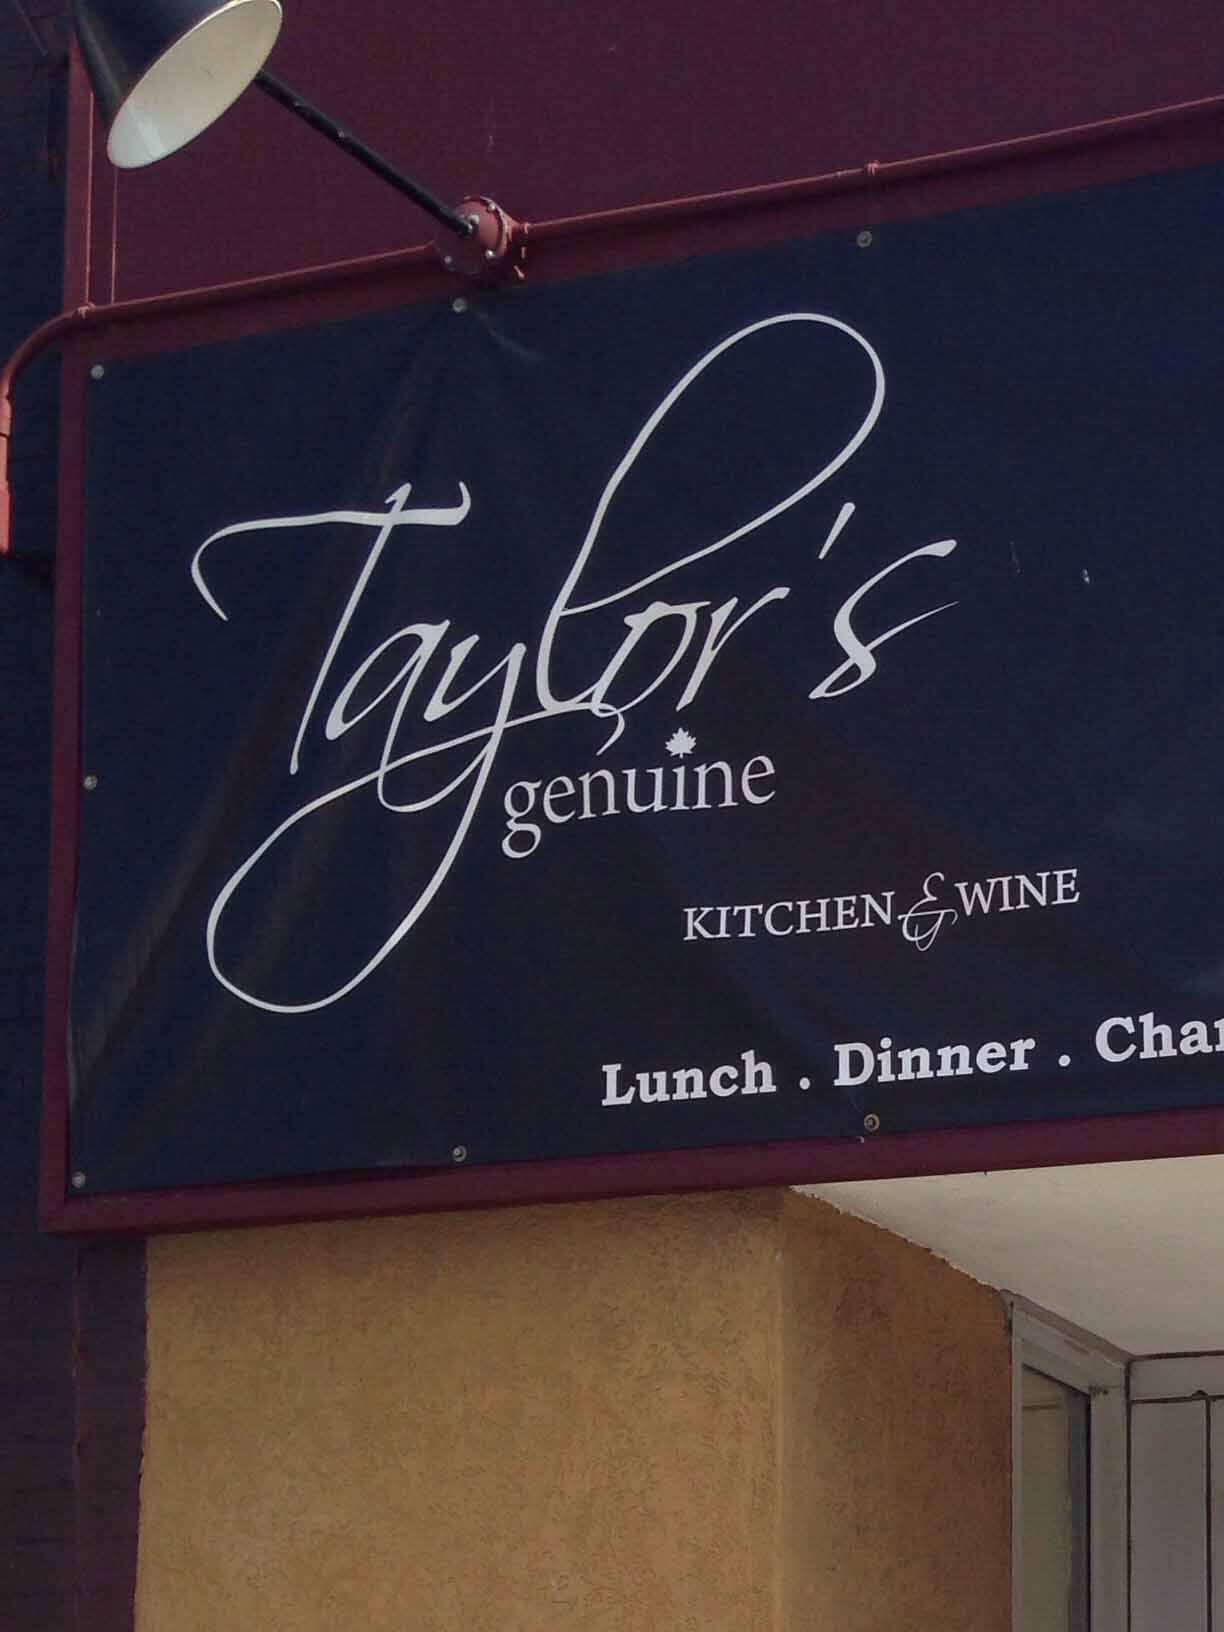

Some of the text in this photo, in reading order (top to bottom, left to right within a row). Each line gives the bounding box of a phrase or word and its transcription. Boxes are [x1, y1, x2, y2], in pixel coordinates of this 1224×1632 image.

[190, 311, 959, 1014] Taylor's
[501, 727, 777, 858] genuine
[682, 891, 896, 942] KITCHEN
[954, 868, 1080, 917] WINE
[601, 1050, 777, 1106] Lunch
[833, 1037, 1036, 1087] Dinner
